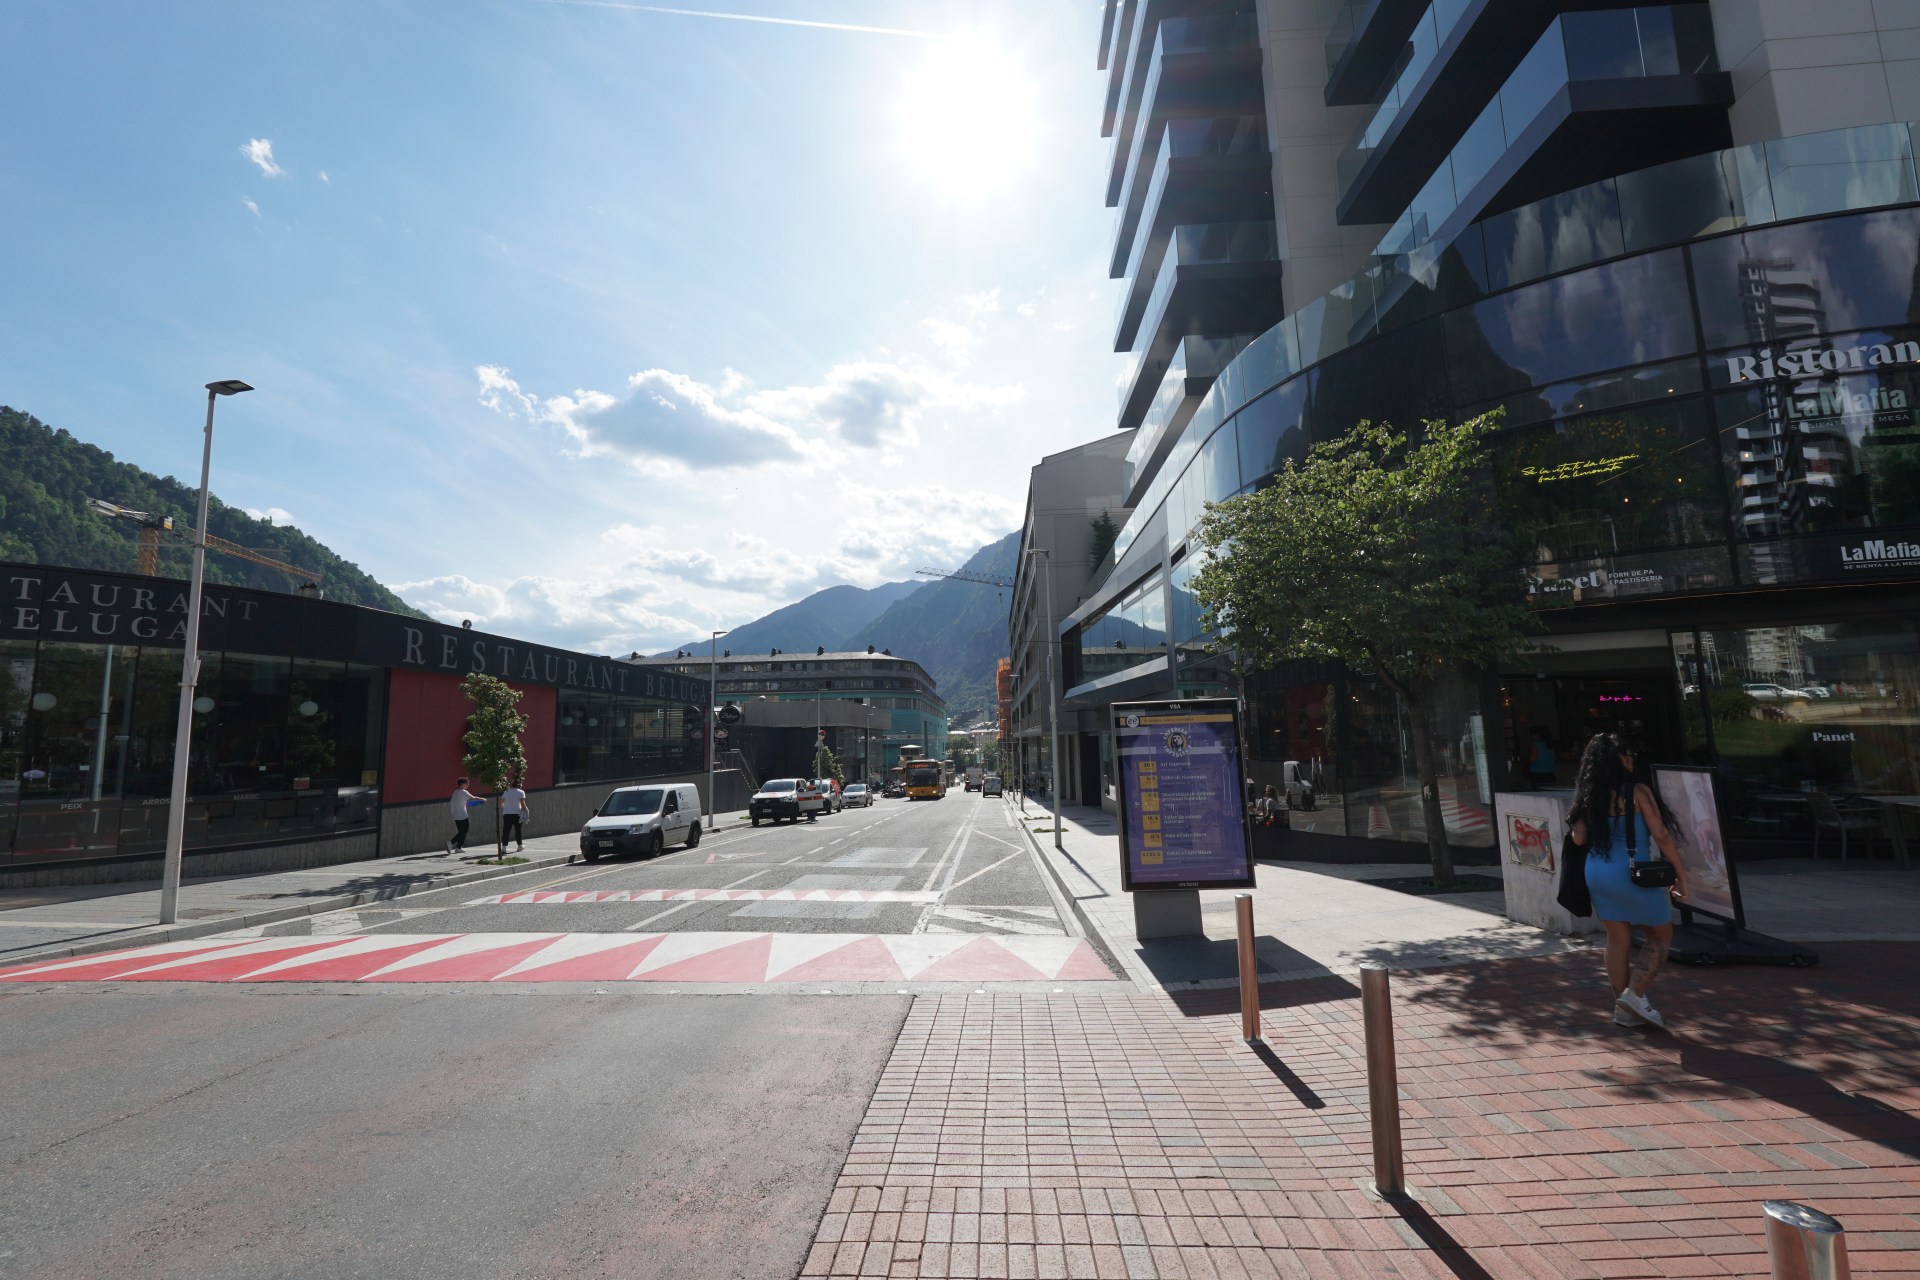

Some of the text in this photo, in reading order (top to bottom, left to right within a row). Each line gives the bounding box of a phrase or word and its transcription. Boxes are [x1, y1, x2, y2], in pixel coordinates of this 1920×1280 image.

[1725, 340, 1920, 384] Ristoran
[1879, 414, 1910, 423] MESA
[1840, 539, 1920, 562] LaMafia
[1609, 571, 1629, 579] FORN
[1614, 575, 1664, 585] PASTISSERIA
[0, 607, 189, 641] ELUGA
[402, 627, 707, 704] RESTAURANT BELUGA
[1812, 732, 1857, 742] Panet
[233, 793, 260, 801] MARISC
[60, 802, 83, 810] PEIX
